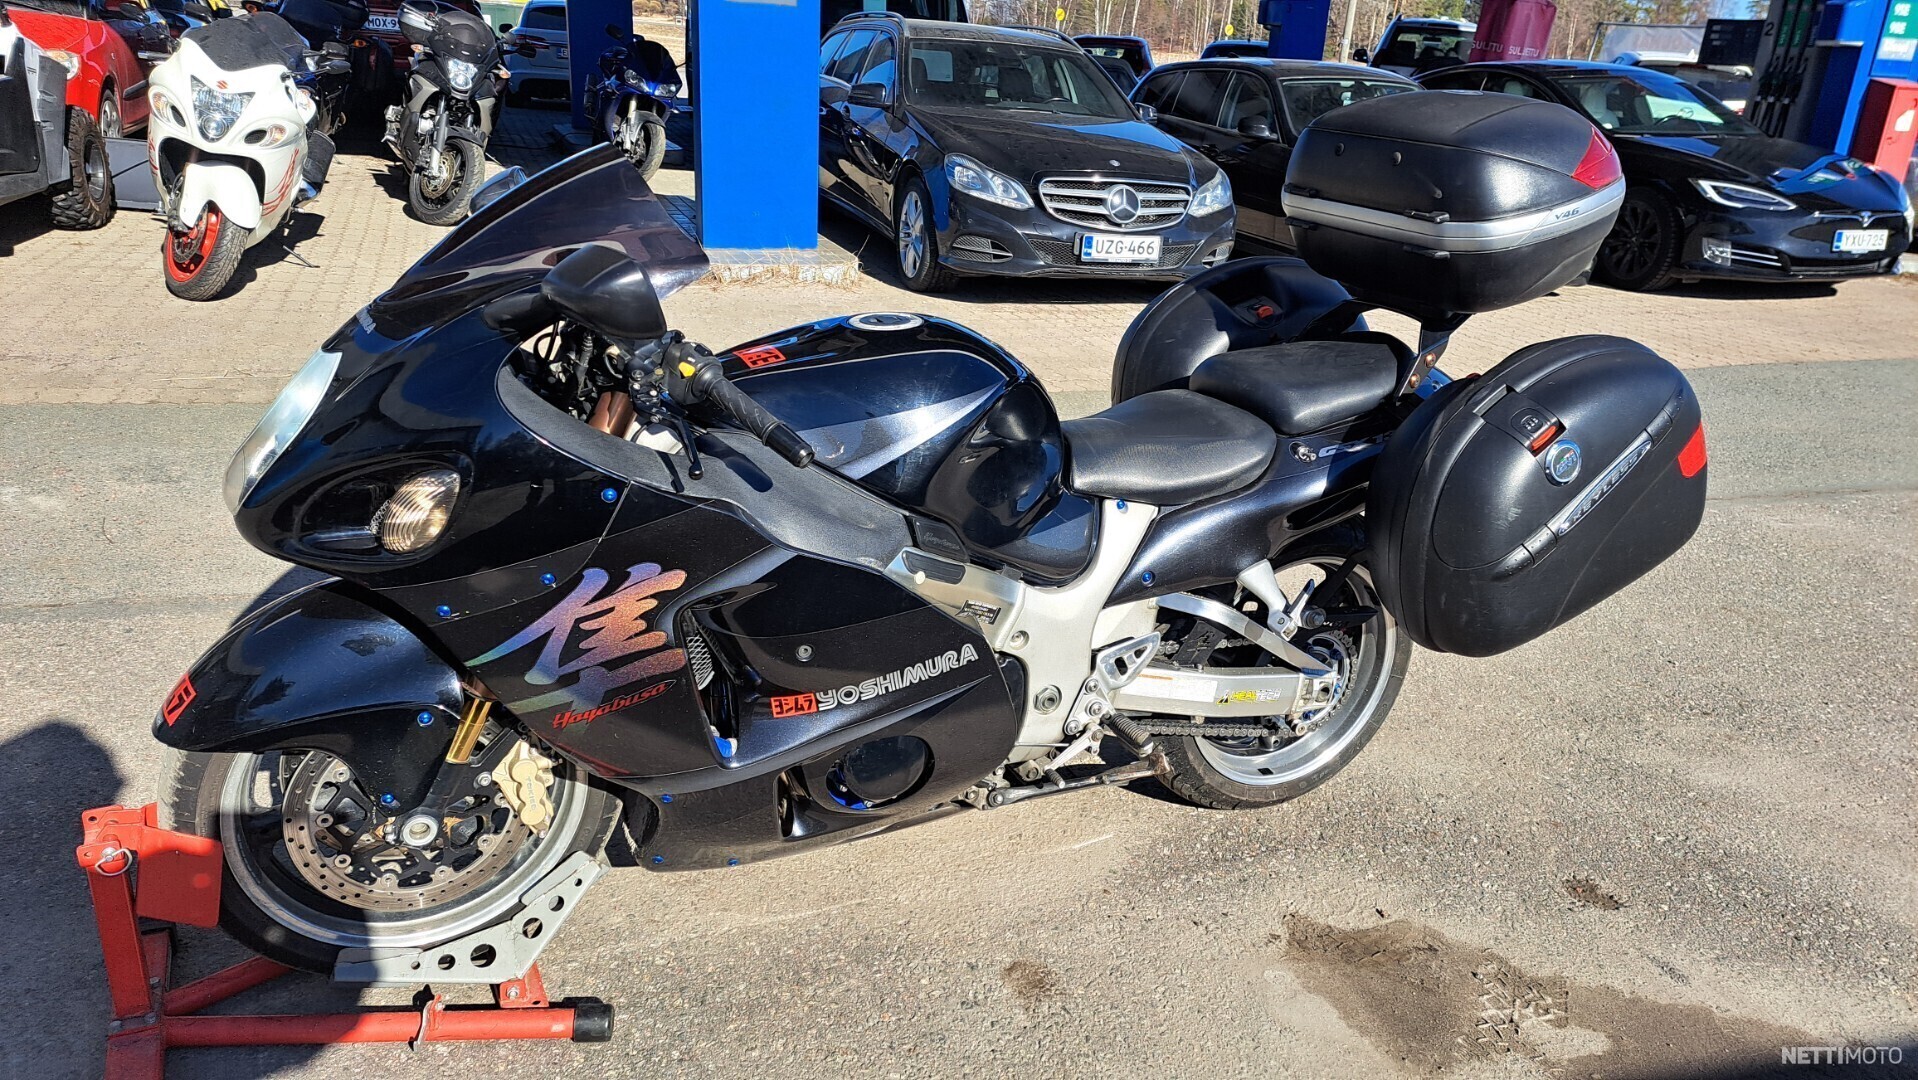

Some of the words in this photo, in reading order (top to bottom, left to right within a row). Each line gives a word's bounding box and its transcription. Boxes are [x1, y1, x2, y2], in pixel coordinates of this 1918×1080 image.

[1764, 22, 1775, 36] 2
[1555, 206, 1580, 220] V46
[1096, 239, 1155, 255] UZG-466
[1845, 233, 1885, 247] YXU-725
[815, 643, 979, 711] YOSHIMURA
[552, 682, 669, 729] Hayabusa
[773, 695, 818, 716] ヨシムラ
